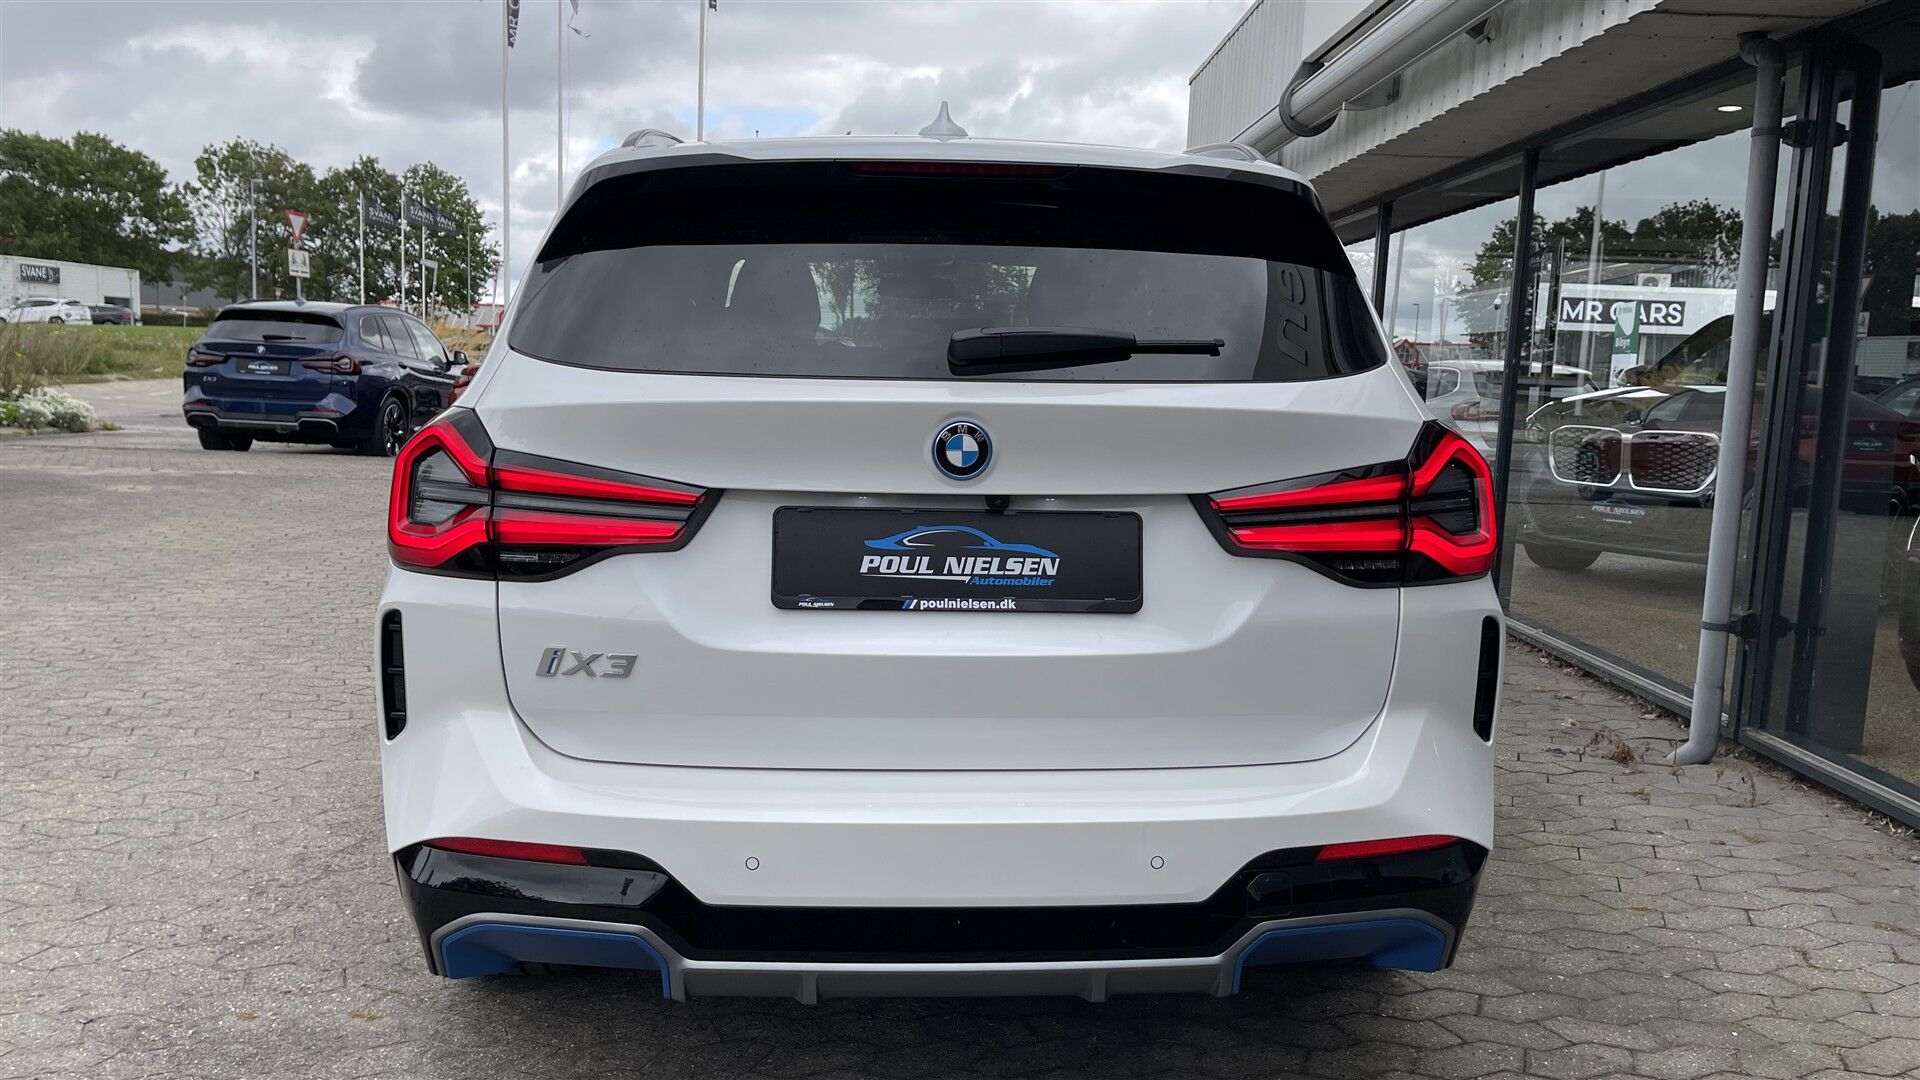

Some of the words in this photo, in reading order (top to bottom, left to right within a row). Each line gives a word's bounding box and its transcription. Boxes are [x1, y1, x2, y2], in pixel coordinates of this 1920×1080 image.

[21, 265, 47, 279] SVANE
[1562, 300, 1603, 321] MR
[941, 425, 985, 443] BMW
[859, 555, 934, 574] POUL
[943, 557, 1060, 576] NIELSEN
[969, 576, 1055, 586] Automobiler
[920, 598, 1016, 610] poulnielsen.dk
[536, 646, 639, 678] iX3
